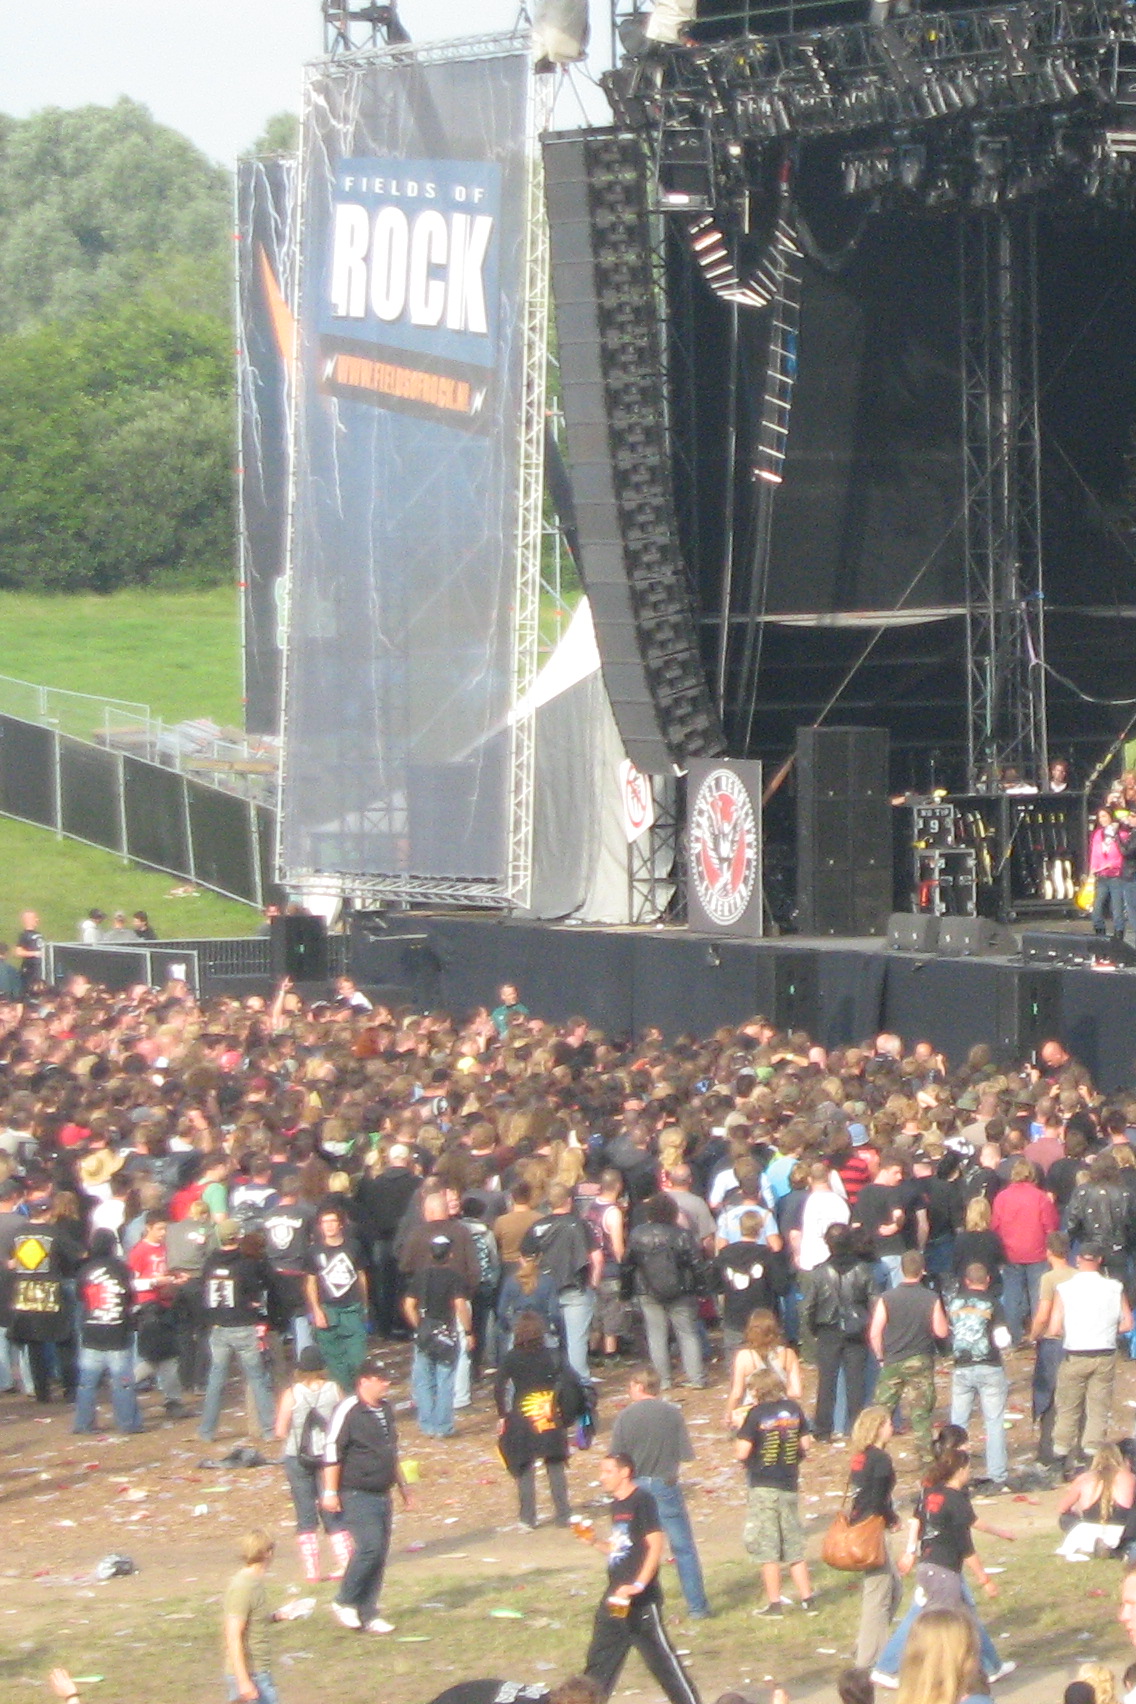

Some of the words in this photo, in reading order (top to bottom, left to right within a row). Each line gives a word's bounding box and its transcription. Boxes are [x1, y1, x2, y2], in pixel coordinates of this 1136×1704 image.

[344, 177, 436, 199] FIELDS
[455, 186, 485, 204] OF
[331, 203, 493, 335] ROCK
